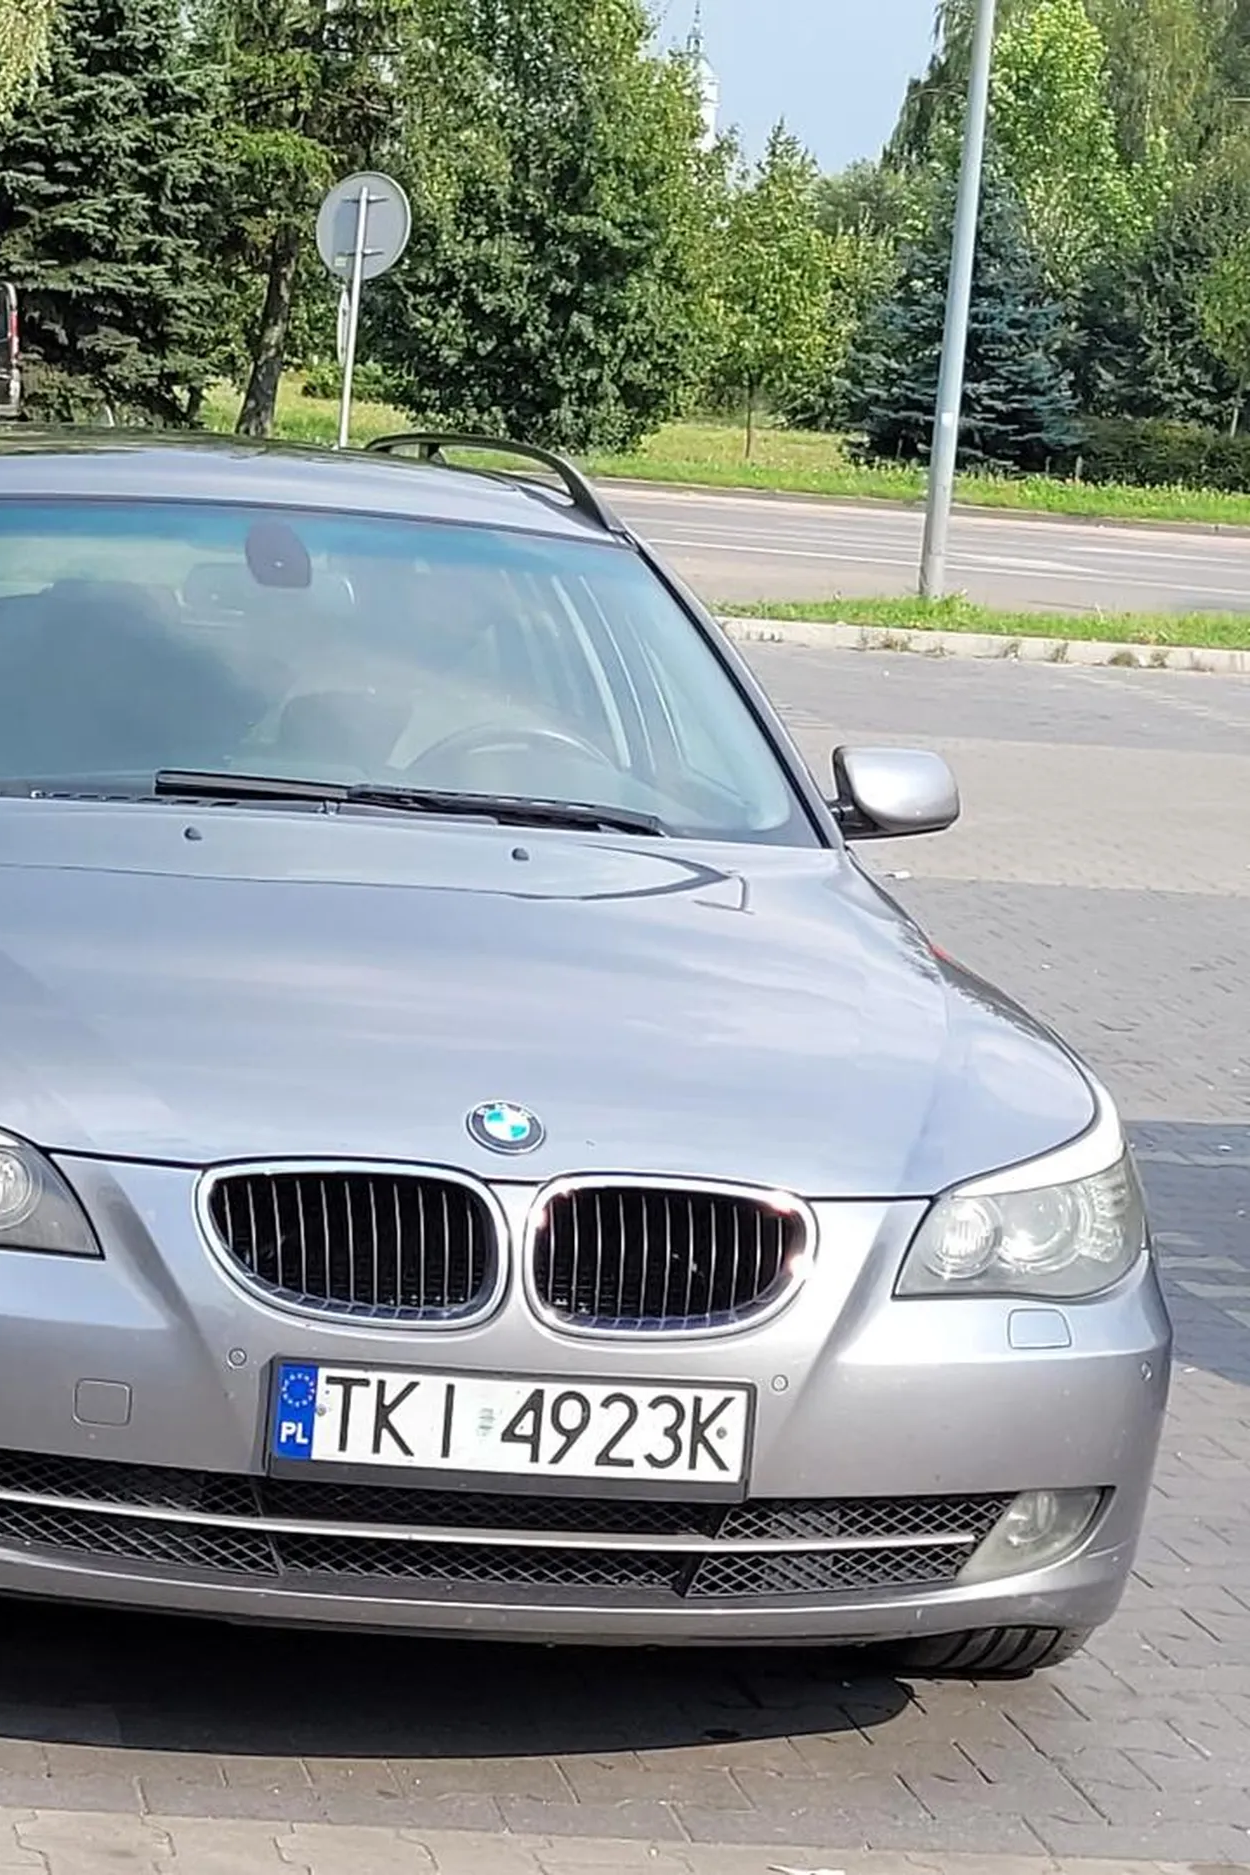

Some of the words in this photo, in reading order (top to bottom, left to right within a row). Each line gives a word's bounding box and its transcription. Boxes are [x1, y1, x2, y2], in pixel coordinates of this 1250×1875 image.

[280, 1421, 309, 1445] PL
[325, 1376, 455, 1458] TKI
[500, 1388, 737, 1471] 4923K
